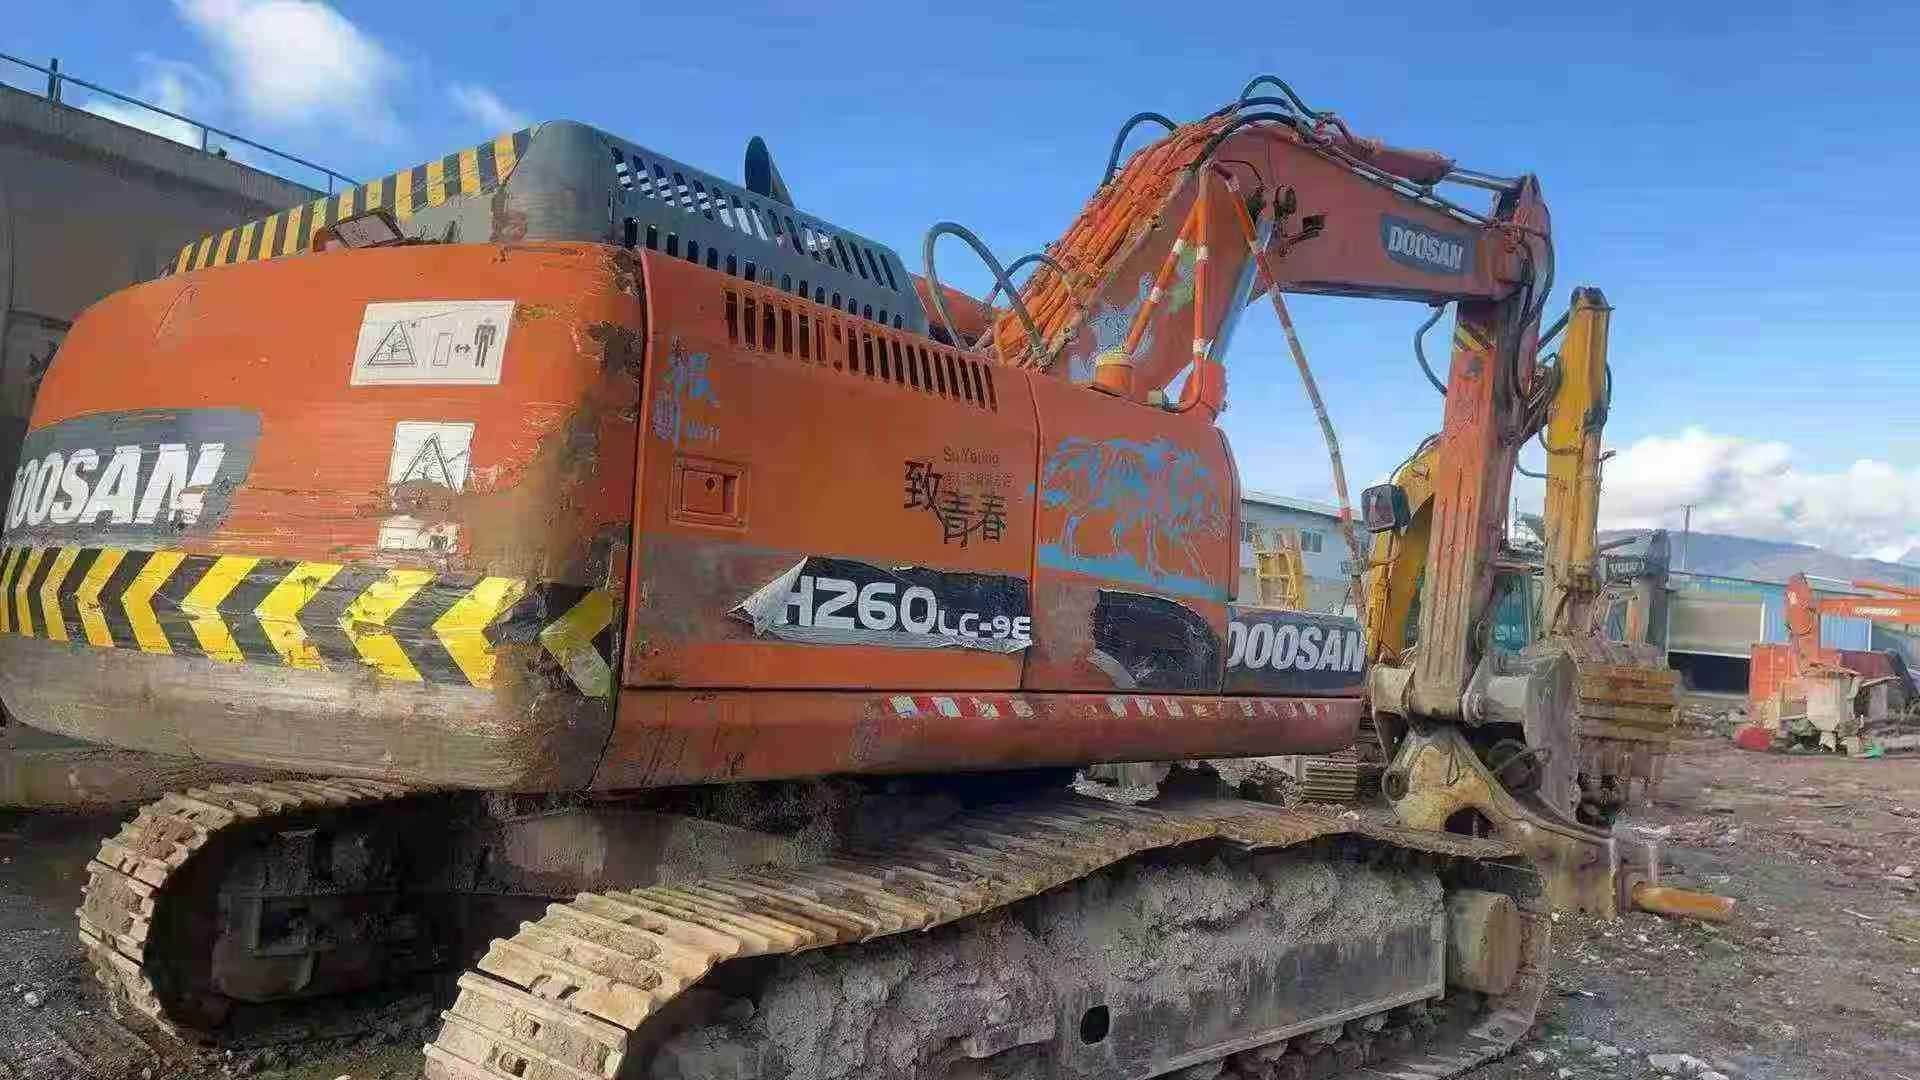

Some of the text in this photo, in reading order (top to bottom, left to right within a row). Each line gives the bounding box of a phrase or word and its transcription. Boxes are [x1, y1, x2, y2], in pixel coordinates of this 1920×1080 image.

[1387, 225, 1464, 270] DOOSAN
[903, 460, 1009, 551] 致青春
[1226, 621, 1367, 672] DOOSAN
